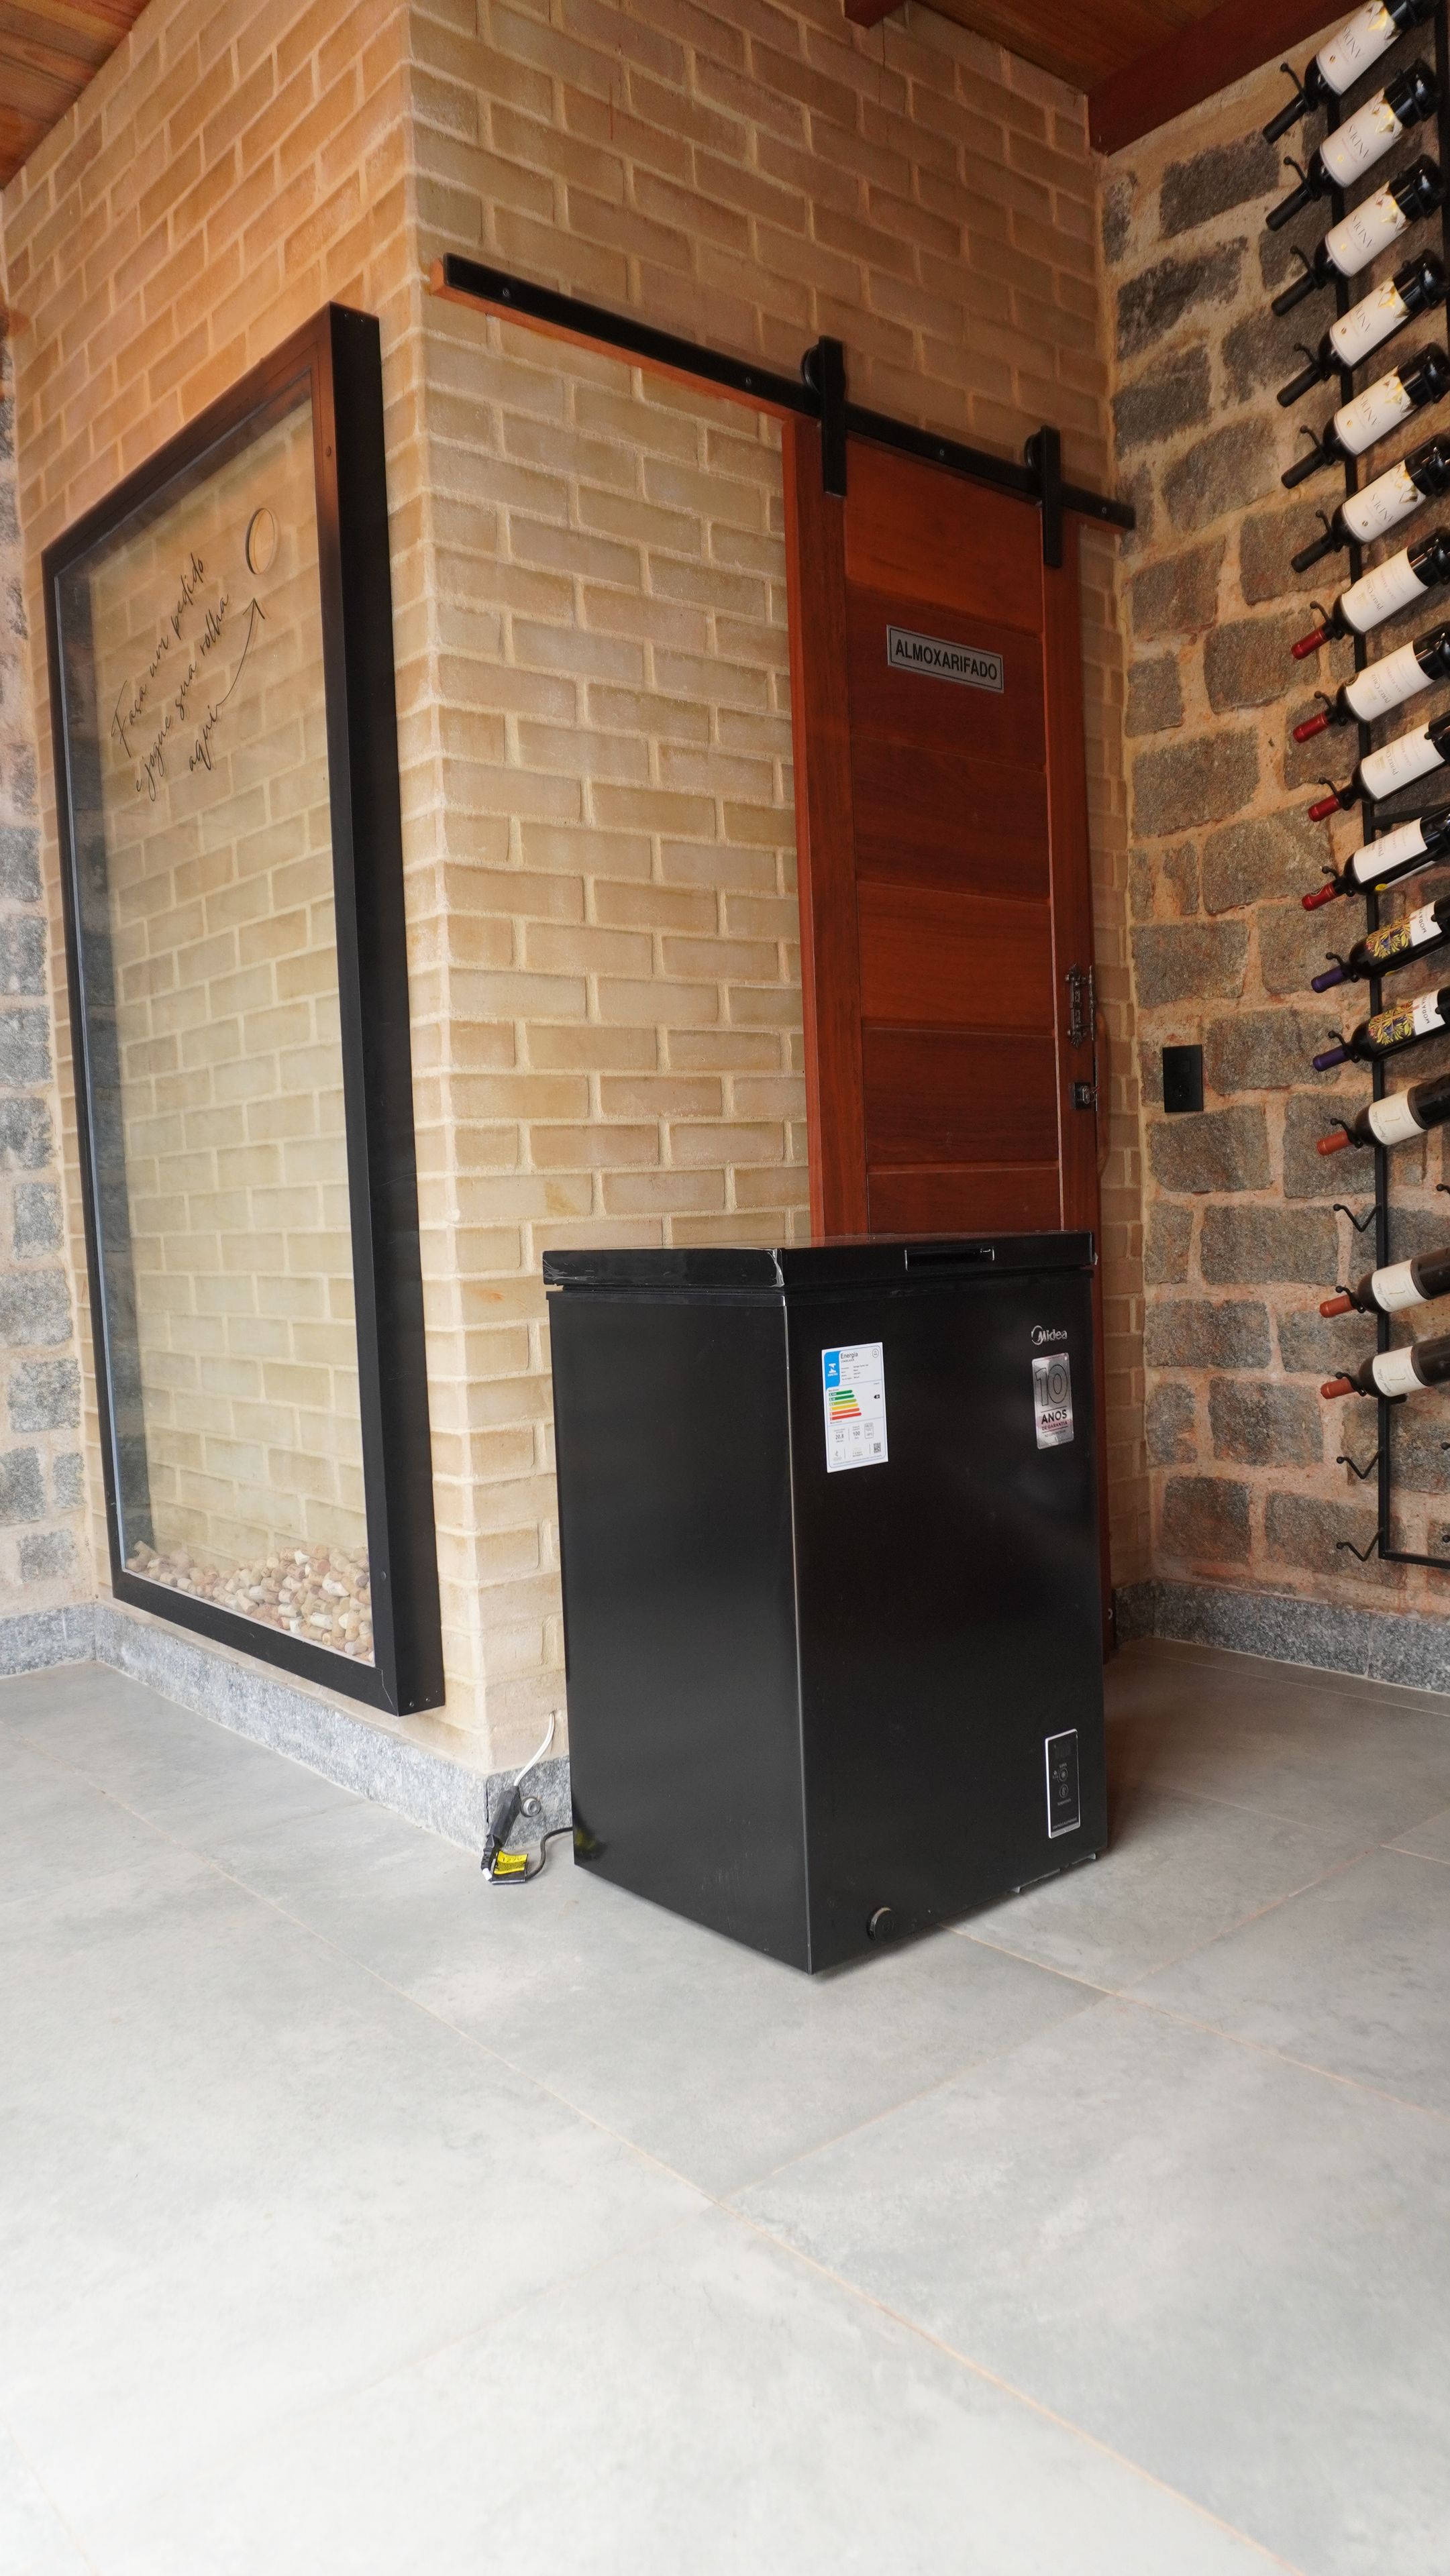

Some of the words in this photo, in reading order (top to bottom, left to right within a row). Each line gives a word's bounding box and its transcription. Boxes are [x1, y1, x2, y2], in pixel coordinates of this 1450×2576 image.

[150, 635, 168, 678] um
[170, 552, 204, 641] pedido
[896, 639, 997, 680] ALMOXARIFADO
[142, 714, 172, 802] jogue
[175, 661, 197, 720] sua
[200, 594, 229, 656] rolha
[189, 704, 218, 771] aqui
[841, 1351, 858, 1360] Energia
[1034, 1328, 1068, 1344] Midea
[1035, 1364, 1068, 1407] 10
[1041, 1409, 1067, 1424] ANOS
